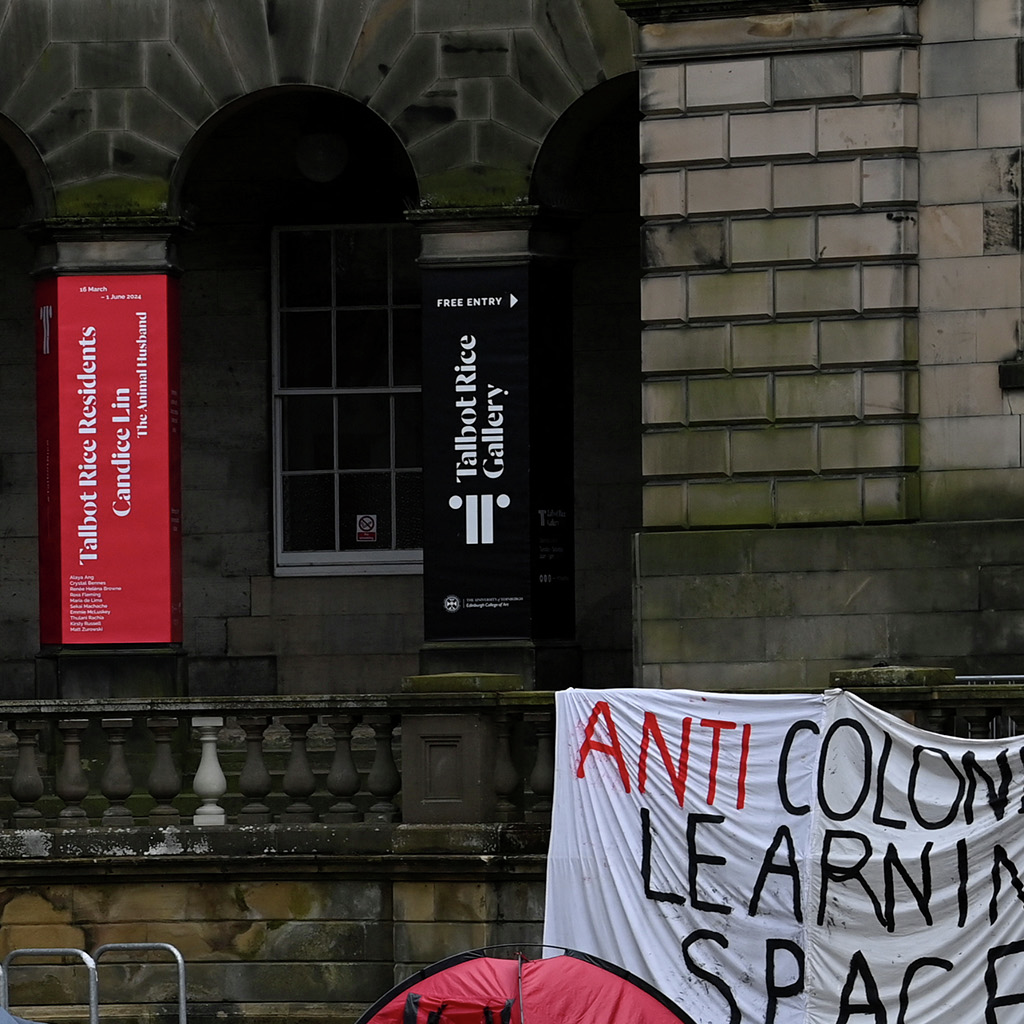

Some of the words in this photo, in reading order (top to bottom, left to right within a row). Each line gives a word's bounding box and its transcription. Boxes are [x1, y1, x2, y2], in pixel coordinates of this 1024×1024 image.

[437, 298, 464, 308] FREE
[466, 297, 502, 307] ENTRY
[135, 311, 148, 367] Husband
[454, 334, 477, 392] Rice
[77, 326, 97, 434] Residents
[111, 388, 130, 423] Lin
[136, 369, 148, 412] Animal
[136, 413, 148, 439] The
[454, 396, 478, 483] Talbot
[481, 383, 509, 479] Gallery
[78, 439, 97, 487] Rice
[111, 427, 131, 517] Candice
[78, 491, 98, 566] Talbot
[576, 701, 751, 810] ANTI
[640, 807, 1024, 932] LEARNIN
